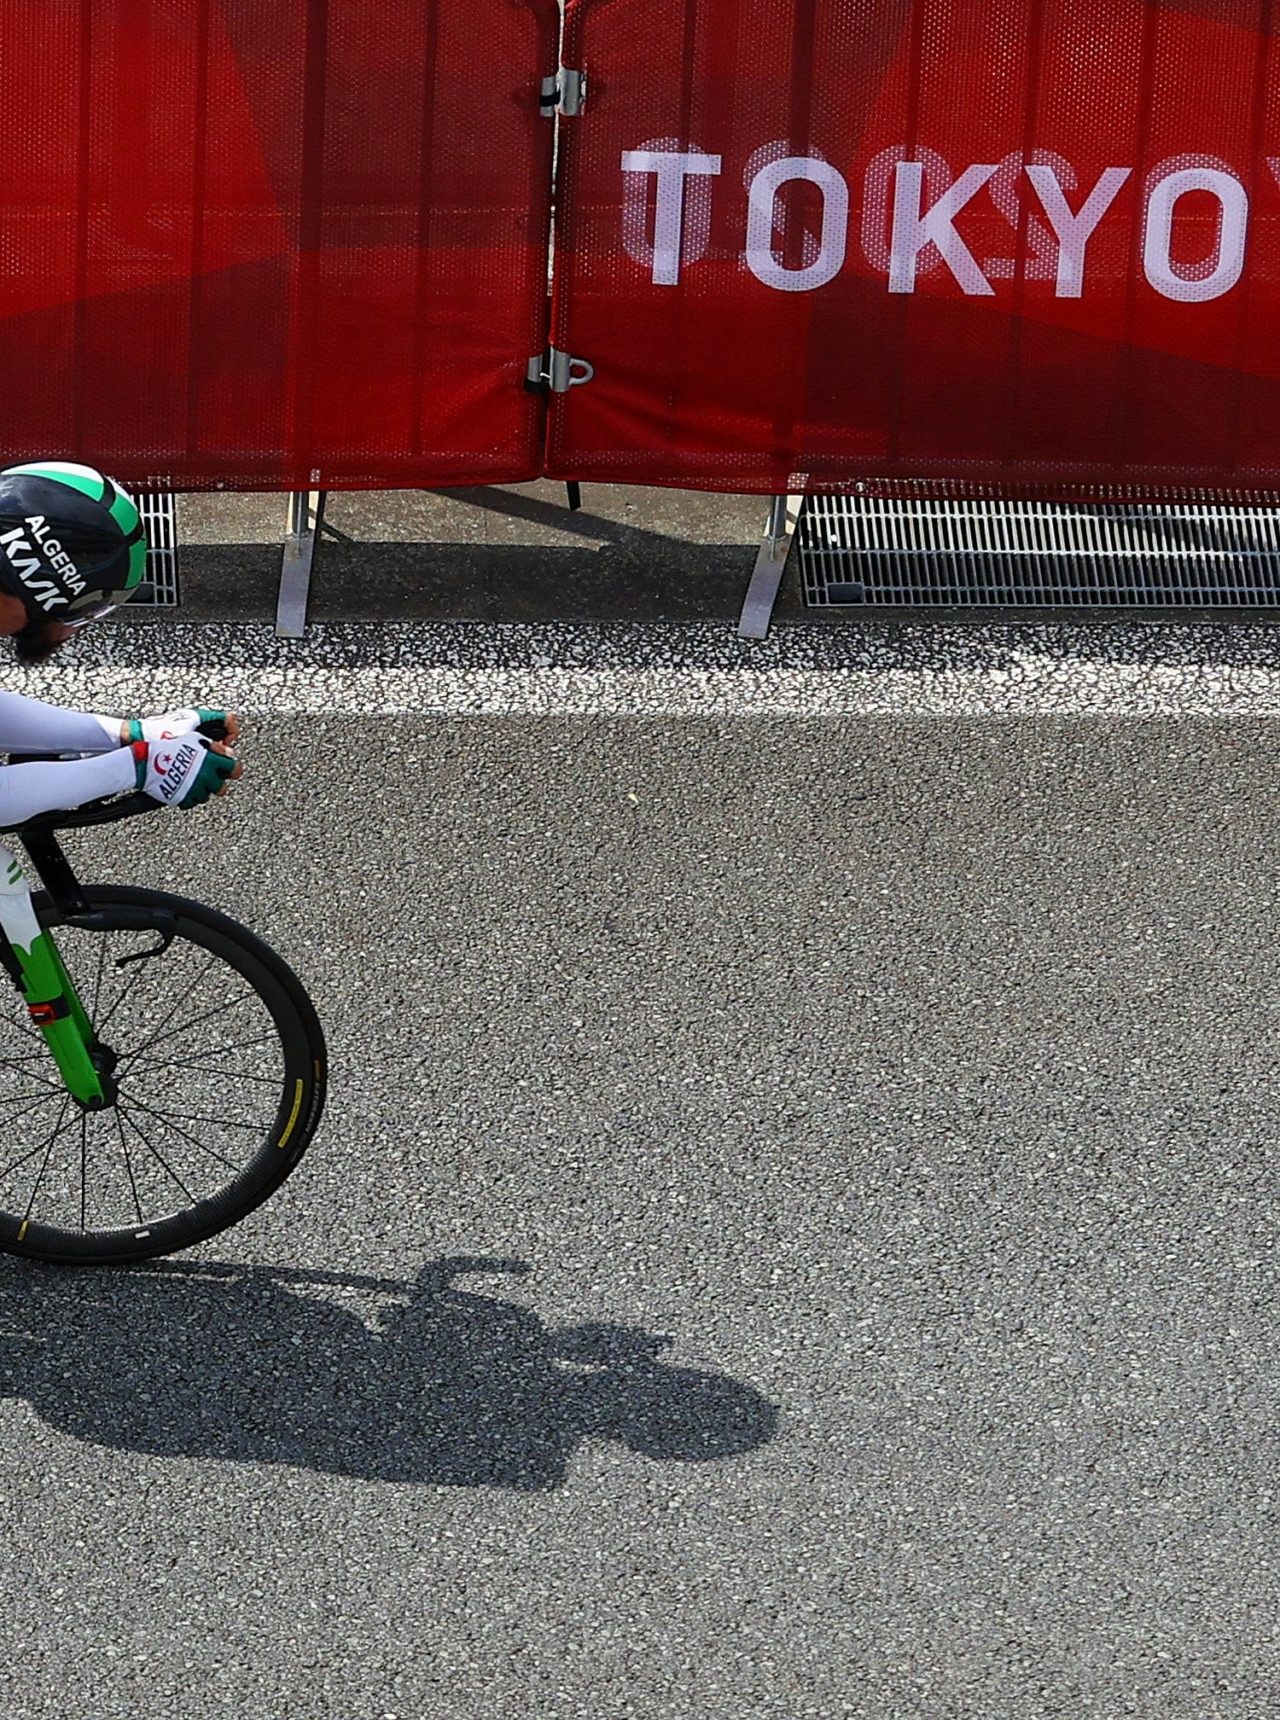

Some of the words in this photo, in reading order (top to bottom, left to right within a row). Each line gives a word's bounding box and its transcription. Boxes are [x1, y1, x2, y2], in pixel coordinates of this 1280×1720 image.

[621, 151, 1249, 302] TOKYO
[24, 515, 87, 596] ALGERIA
[159, 744, 197, 800] ALGERIA
